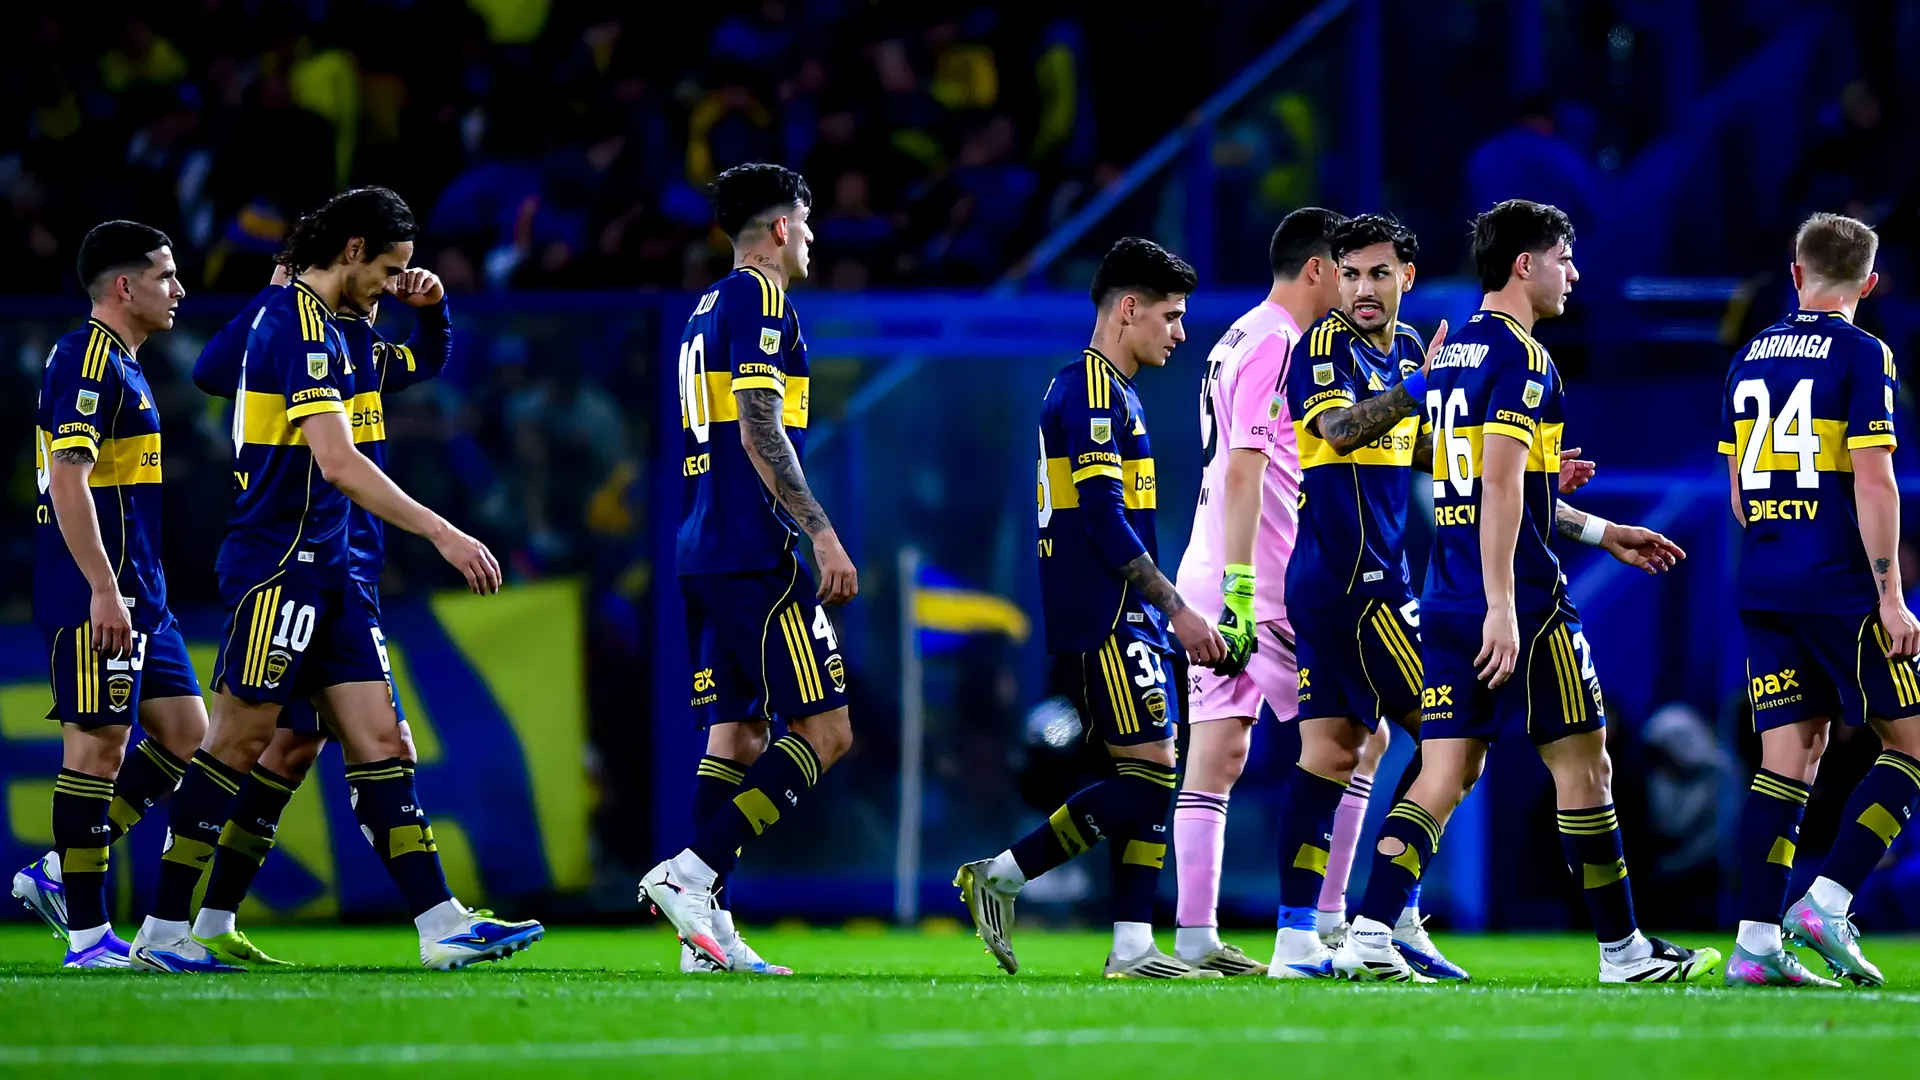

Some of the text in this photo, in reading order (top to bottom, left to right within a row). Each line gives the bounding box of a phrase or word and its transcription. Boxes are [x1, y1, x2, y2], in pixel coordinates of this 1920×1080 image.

[1744, 335, 1832, 361] BARINAGA
[1733, 378, 1820, 490] 24
[272, 600, 316, 652] 10
[1752, 668, 1800, 704] pax
